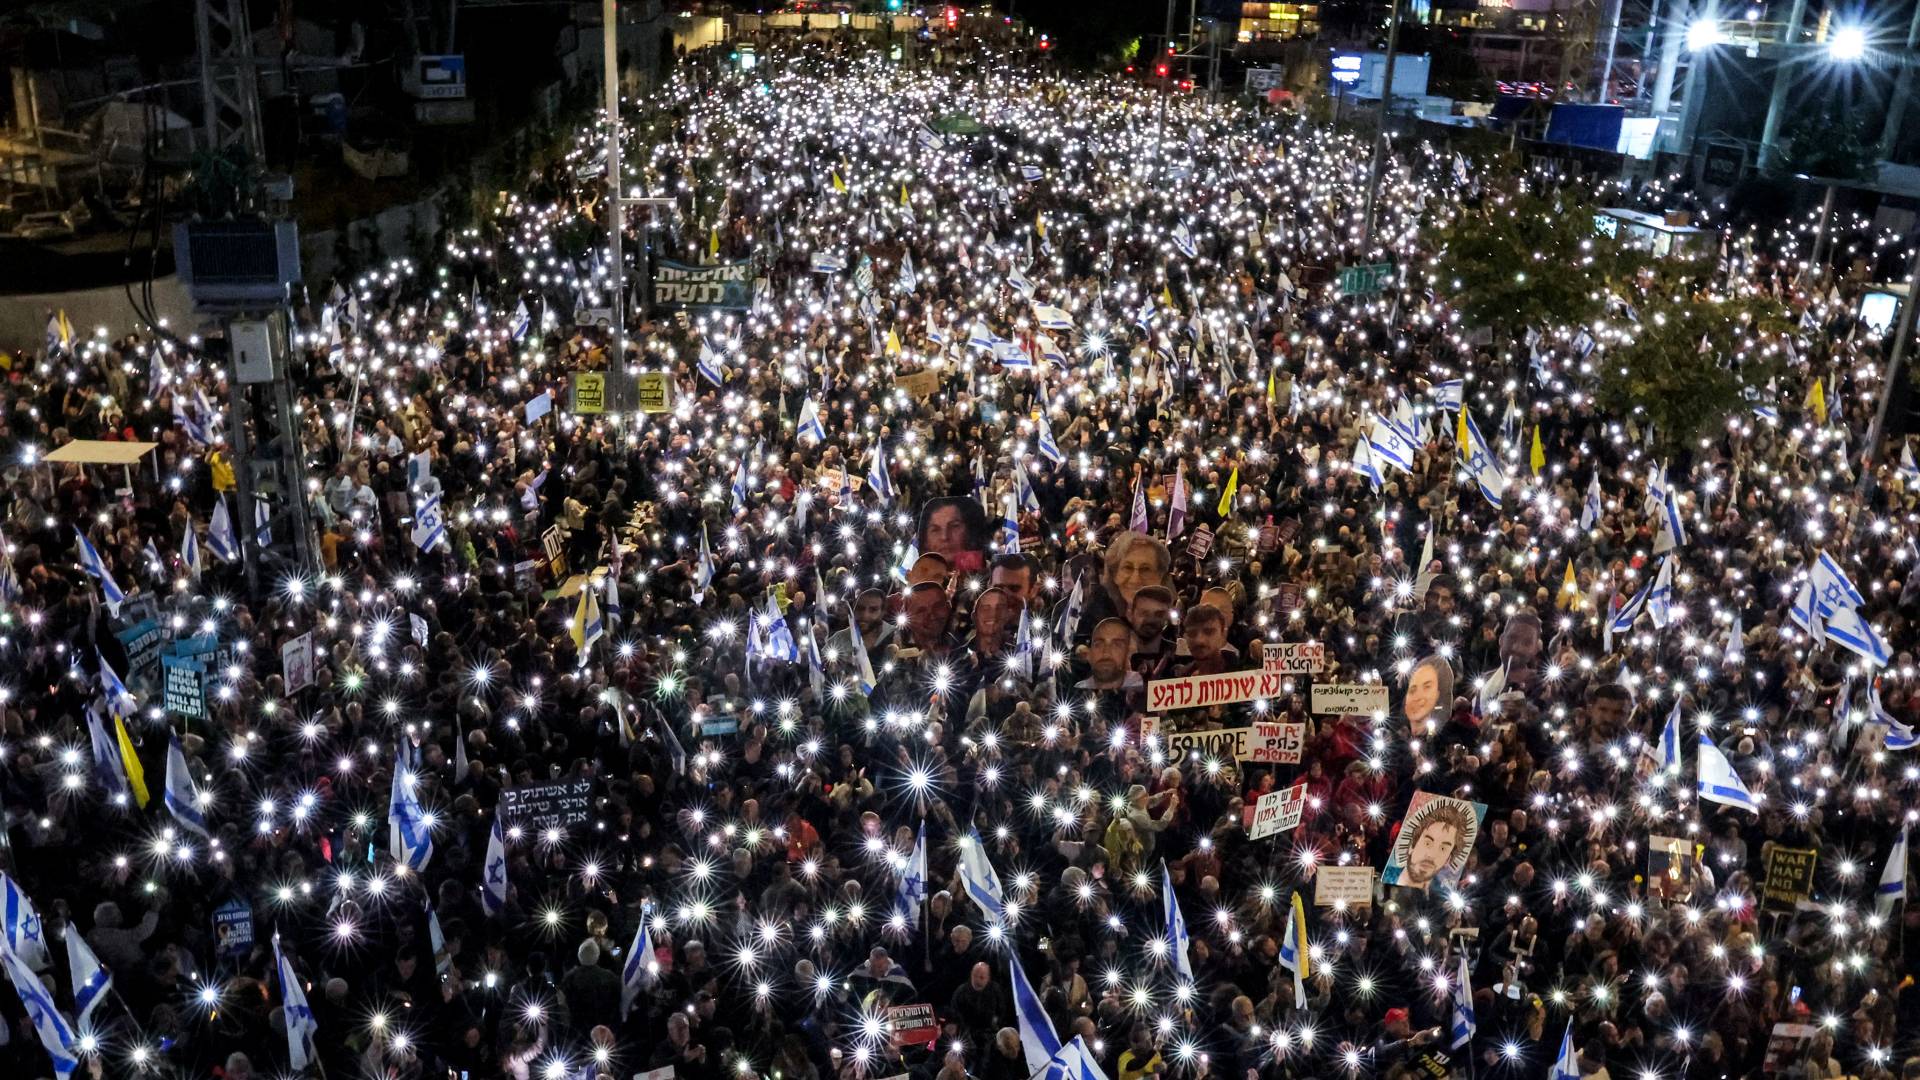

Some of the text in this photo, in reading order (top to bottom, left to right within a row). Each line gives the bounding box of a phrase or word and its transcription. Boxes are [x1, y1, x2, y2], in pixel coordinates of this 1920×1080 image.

[655, 281, 725, 304] לנשק
[578, 390, 601, 400] אשם
[641, 390, 663, 400] אשם
[1284, 644, 1297, 657] לא
[1298, 644, 1323, 657] ישראל
[171, 665, 195, 677] HOW
[168, 674, 198, 687] MUCH
[168, 683, 200, 697] BLOOD
[1153, 679, 1192, 707] לרגע
[1197, 675, 1254, 705] שוכחות
[1354, 688, 1370, 696] כיס
[167, 693, 201, 707] WILL BE
[167, 703, 202, 716] SPILLED?
[1256, 725, 1280, 738] מחר
[1197, 731, 1248, 757] MORE
[504, 779, 591, 804] לא אשתוק כי
[1265, 790, 1292, 807] יש לנו
[508, 796, 588, 815] ארצי שינתה
[567, 811, 587, 823] את
[1256, 805, 1279, 826] אמון
[1775, 853, 1806, 865] WAR
[1773, 865, 1803, 880] HAS
[1771, 878, 1793, 890] NO
